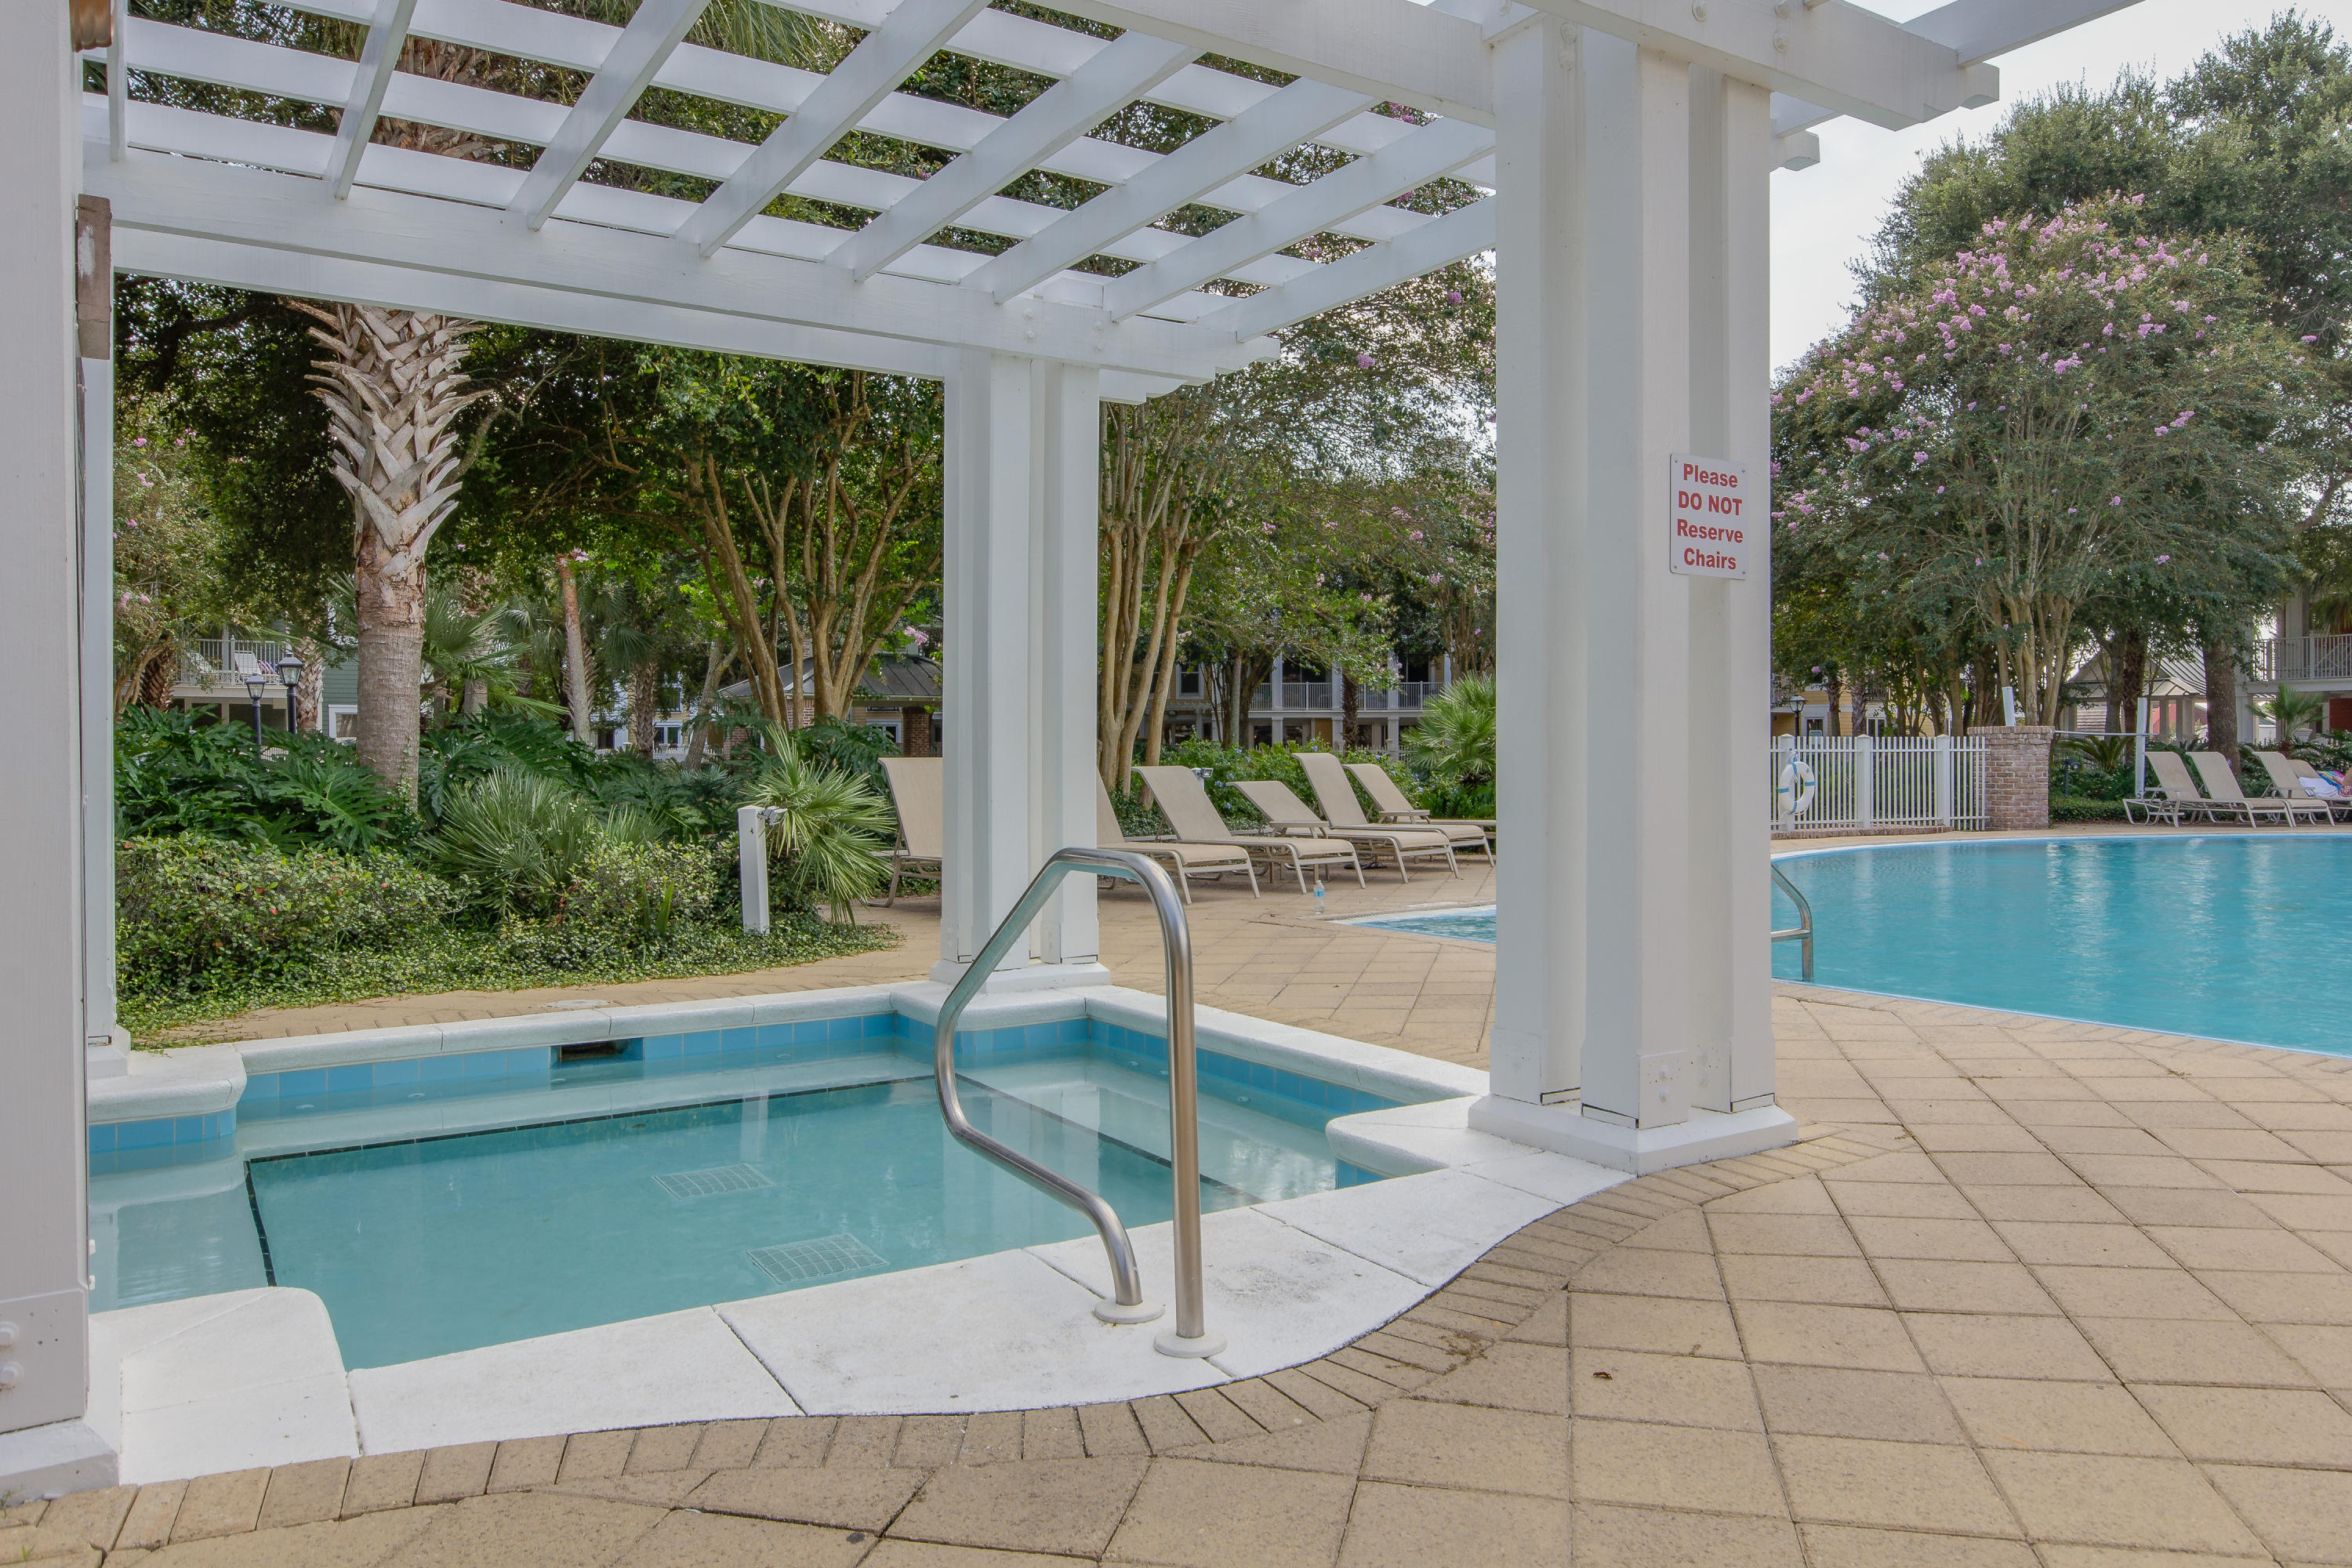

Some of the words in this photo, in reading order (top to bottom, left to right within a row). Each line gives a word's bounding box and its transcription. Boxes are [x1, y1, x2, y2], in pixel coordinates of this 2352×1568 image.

[1683, 463, 1738, 488] Please
[1679, 491, 1702, 510] DO
[1708, 495, 1743, 516] NOT
[1677, 518, 1744, 543] Reserve
[1684, 547, 1737, 570] Chairs
